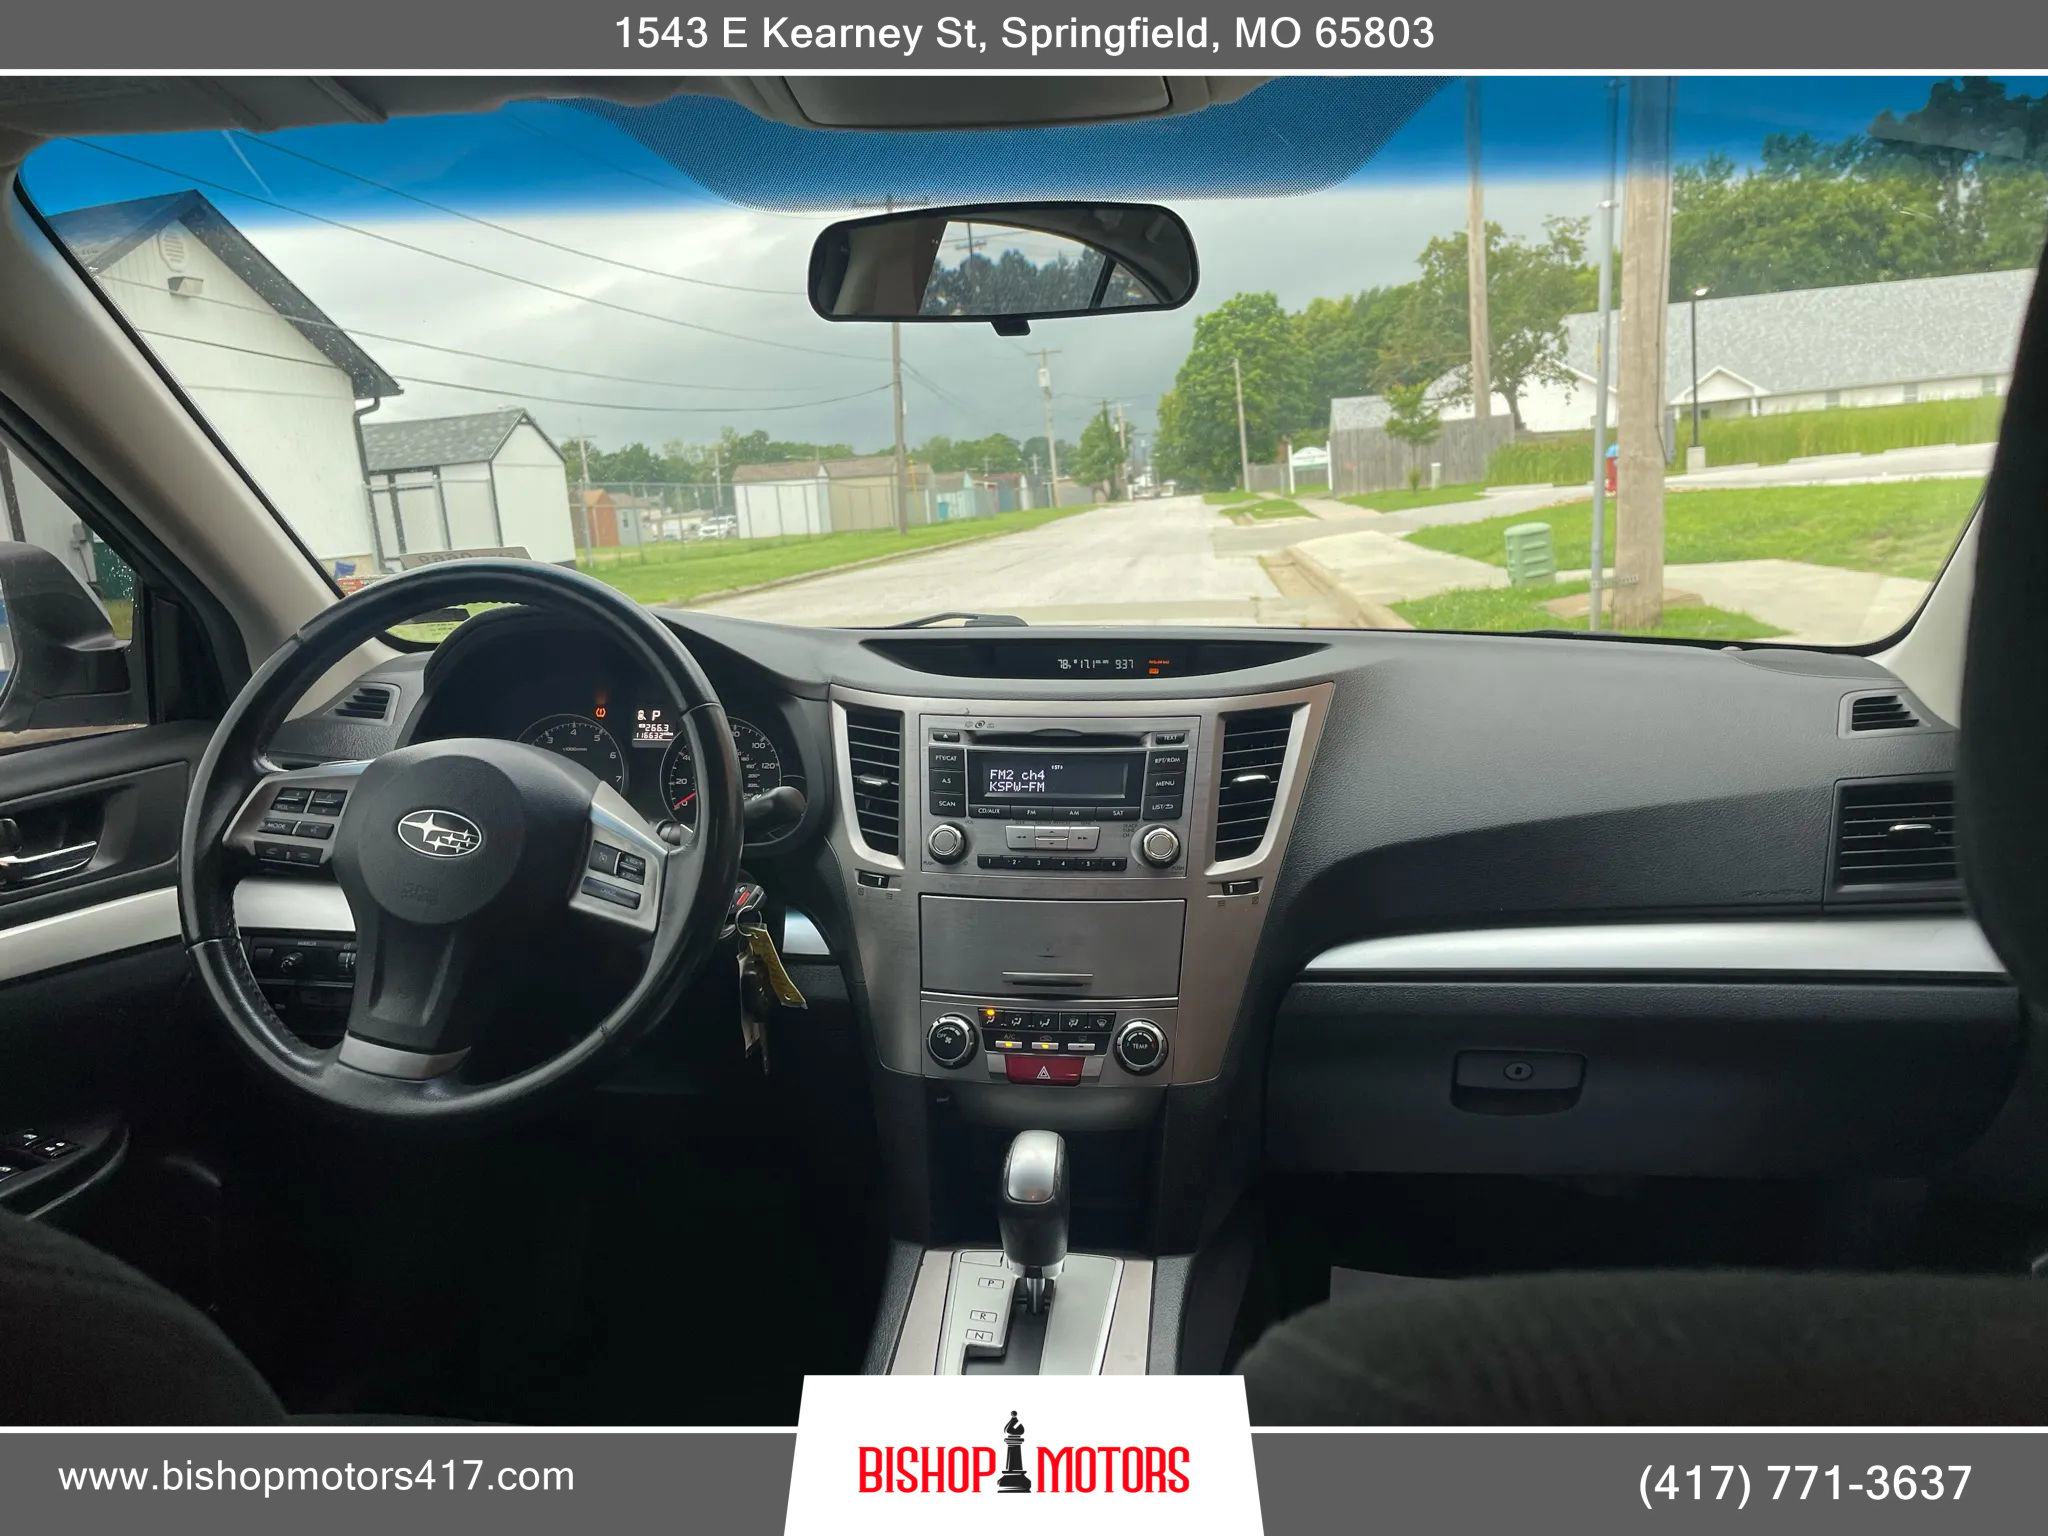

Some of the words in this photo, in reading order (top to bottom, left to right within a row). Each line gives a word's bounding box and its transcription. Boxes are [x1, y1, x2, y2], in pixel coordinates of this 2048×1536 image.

[651, 709, 661, 721] P
[570, 728, 577, 736] 4
[546, 736, 554, 744] 3
[593, 734, 601, 742] 5
[609, 751, 617, 759] 6
[761, 762, 776, 770] 120
[615, 775, 622, 783] 7
[989, 769, 1014, 781] FM2
[1021, 769, 1046, 781] ch4
[989, 781, 1046, 793] KSPW-FM
[938, 800, 956, 808] SCAN
[977, 807, 1001, 815] CD/AUX
[980, 1312, 987, 1320] R
[974, 1332, 985, 1340] N
